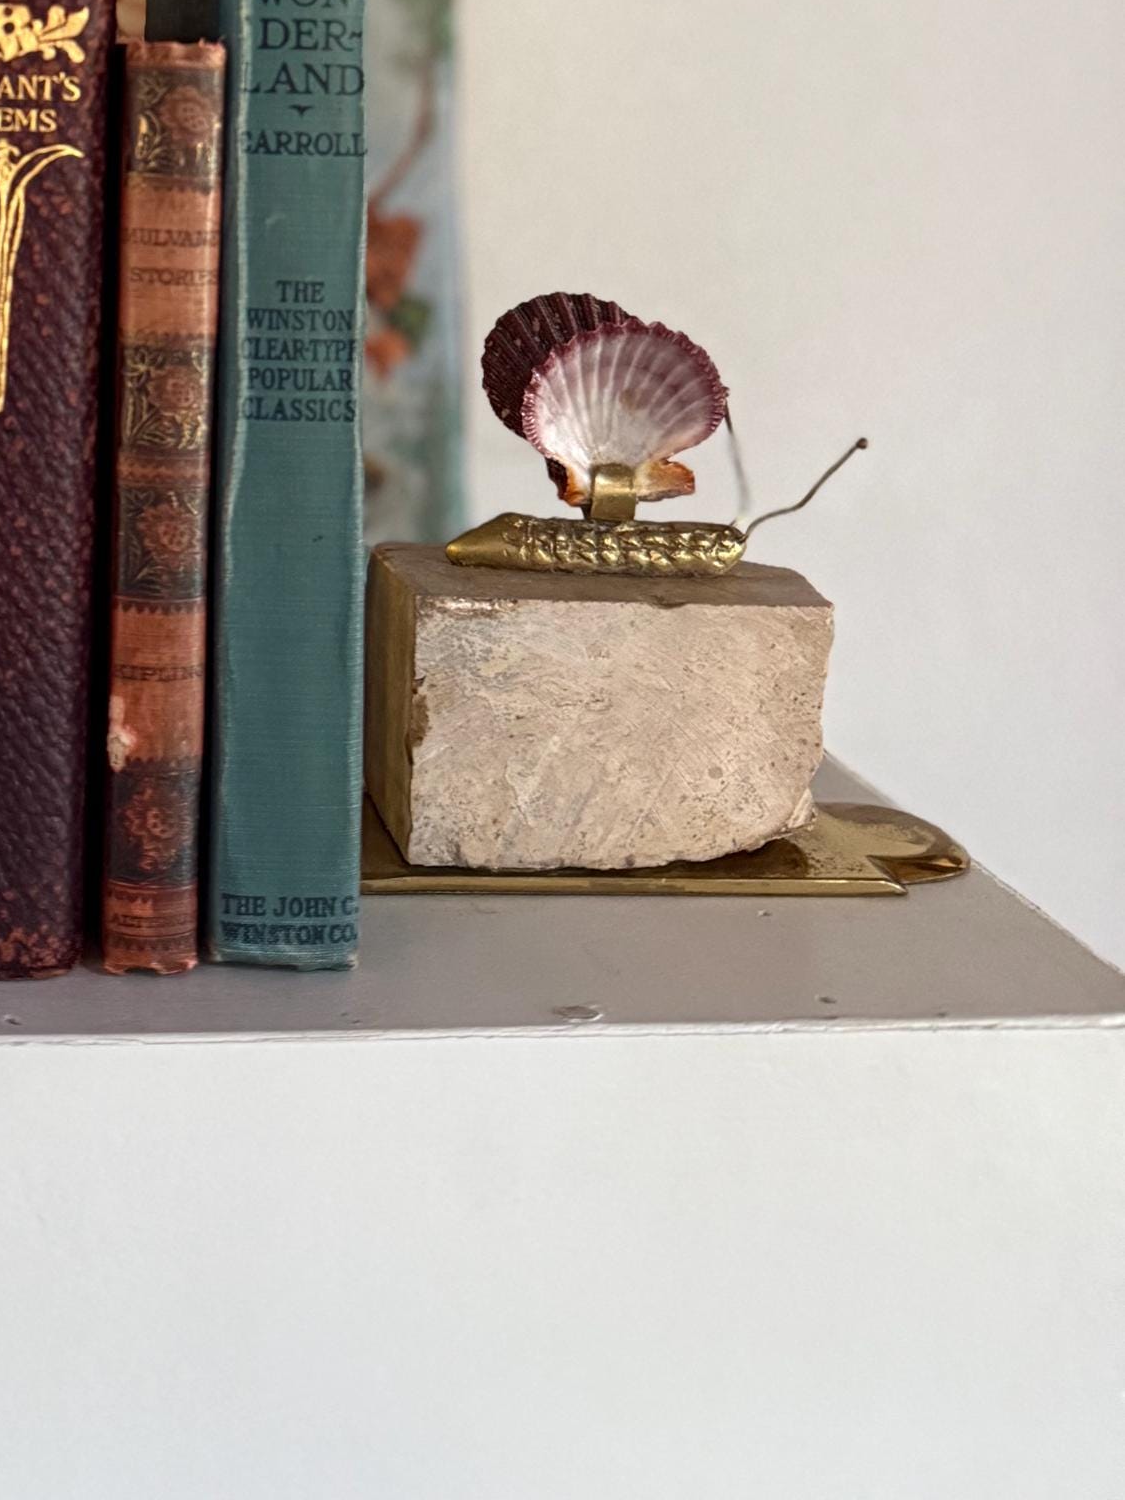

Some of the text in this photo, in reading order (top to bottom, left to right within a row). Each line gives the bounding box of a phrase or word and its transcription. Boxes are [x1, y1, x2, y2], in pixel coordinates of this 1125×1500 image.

[258, 18, 362, 51] DER-
[242, 62, 364, 96] LAND
[276, 280, 325, 303] THE
[246, 308, 355, 332] WINSTON
[248, 367, 353, 392] POPULAR
[243, 397, 356, 422] CLASSICS
[221, 893, 266, 916] THE
[273, 896, 335, 917] JOHN
[220, 920, 326, 945] WINSTON
